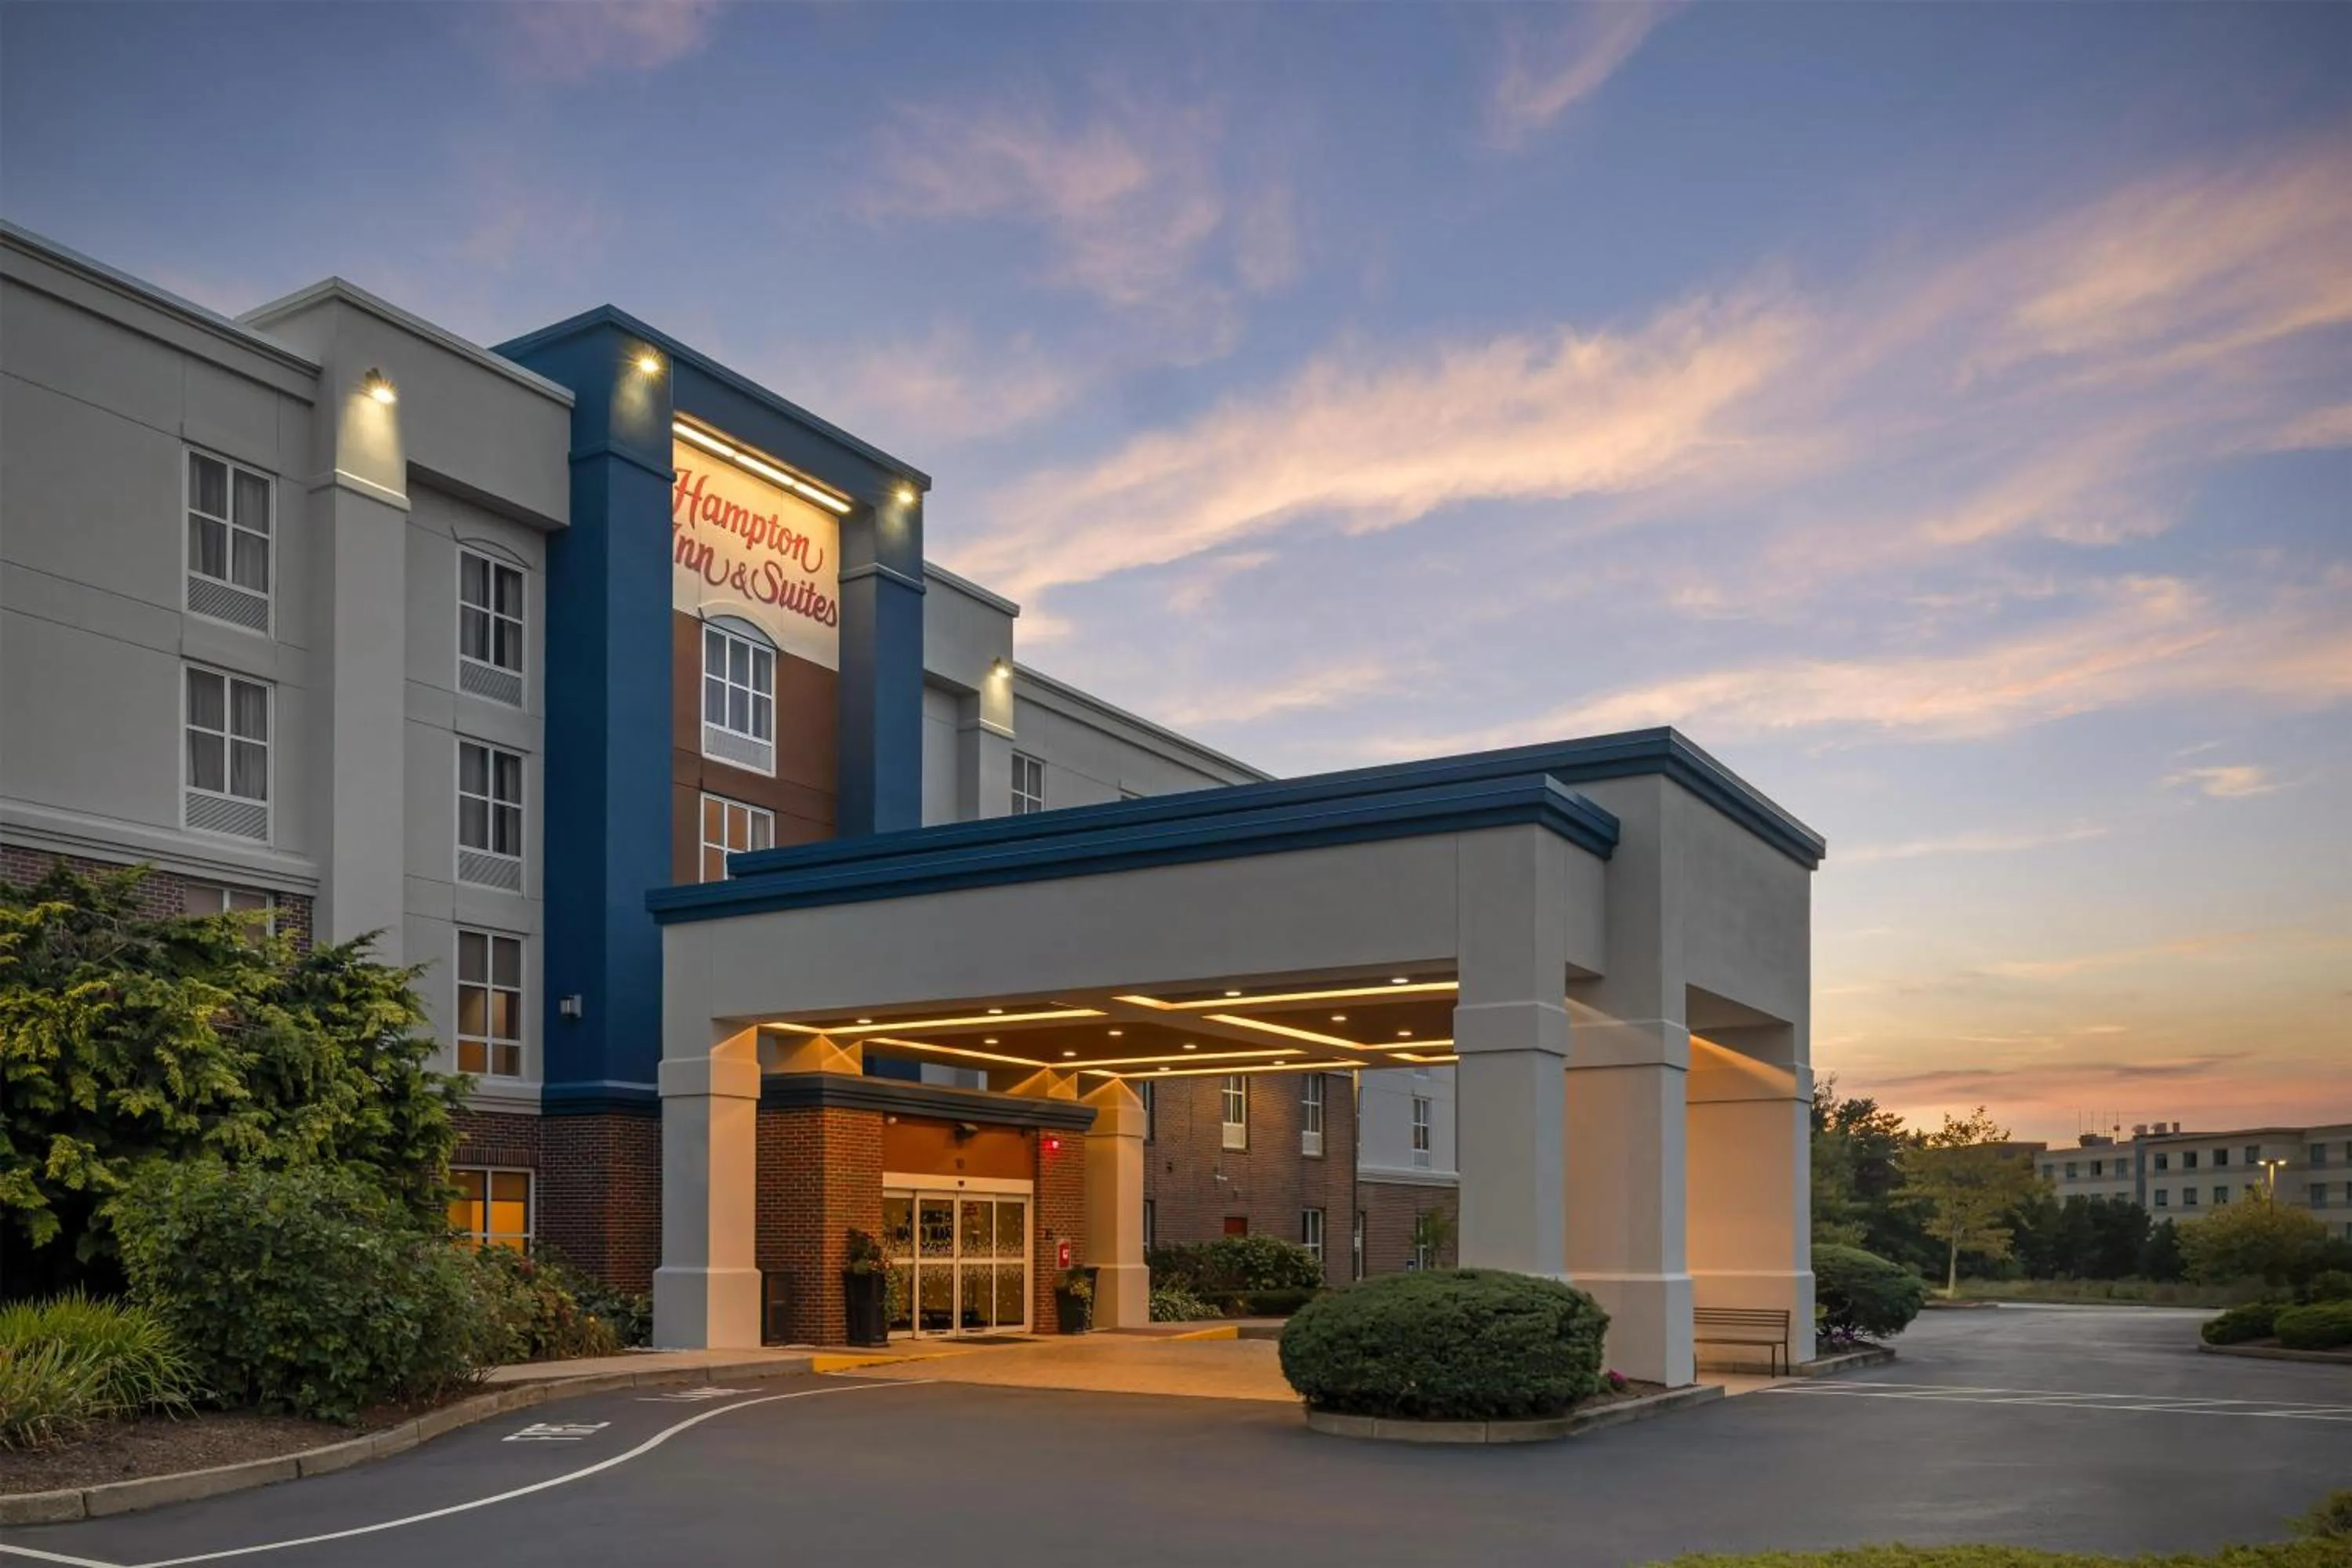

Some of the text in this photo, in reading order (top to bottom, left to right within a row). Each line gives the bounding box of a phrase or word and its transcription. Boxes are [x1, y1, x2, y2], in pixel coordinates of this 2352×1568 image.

[673, 467, 822, 573] Hampton
[673, 523, 837, 628] nn & Suites
